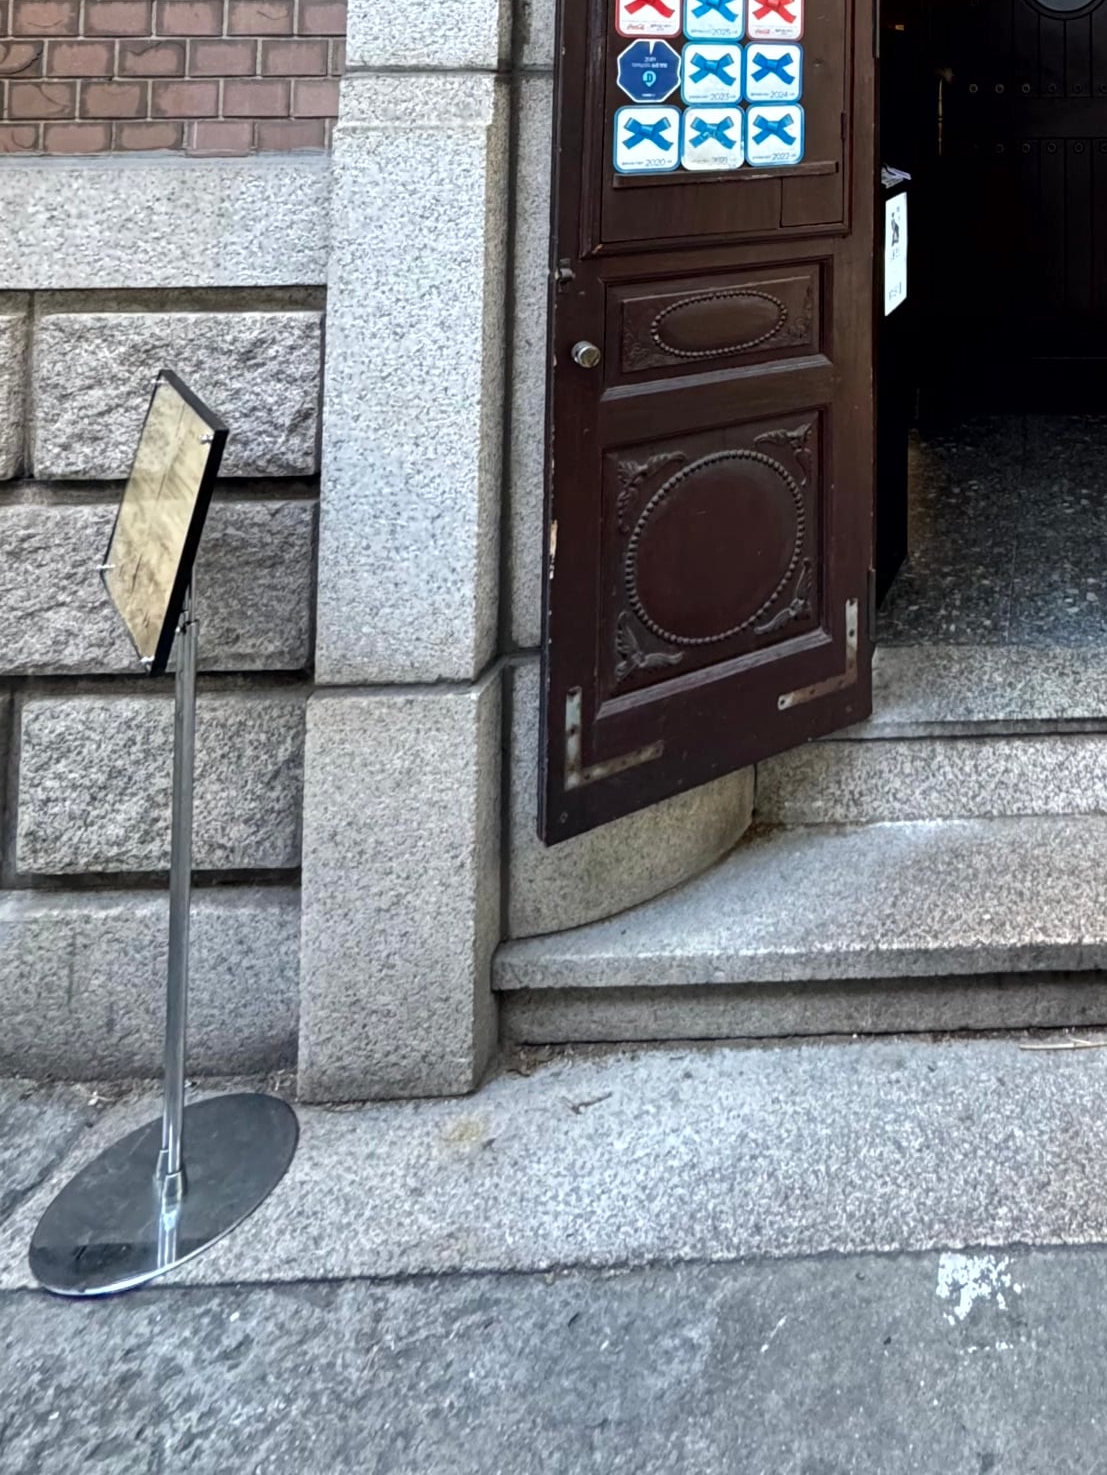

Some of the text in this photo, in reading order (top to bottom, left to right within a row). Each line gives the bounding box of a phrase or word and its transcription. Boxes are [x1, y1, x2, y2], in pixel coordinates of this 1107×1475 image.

[710, 93, 730, 101] 2023
[770, 90, 789, 99] 2024
[771, 152, 791, 161] 2022
[645, 159, 666, 167] 2020
